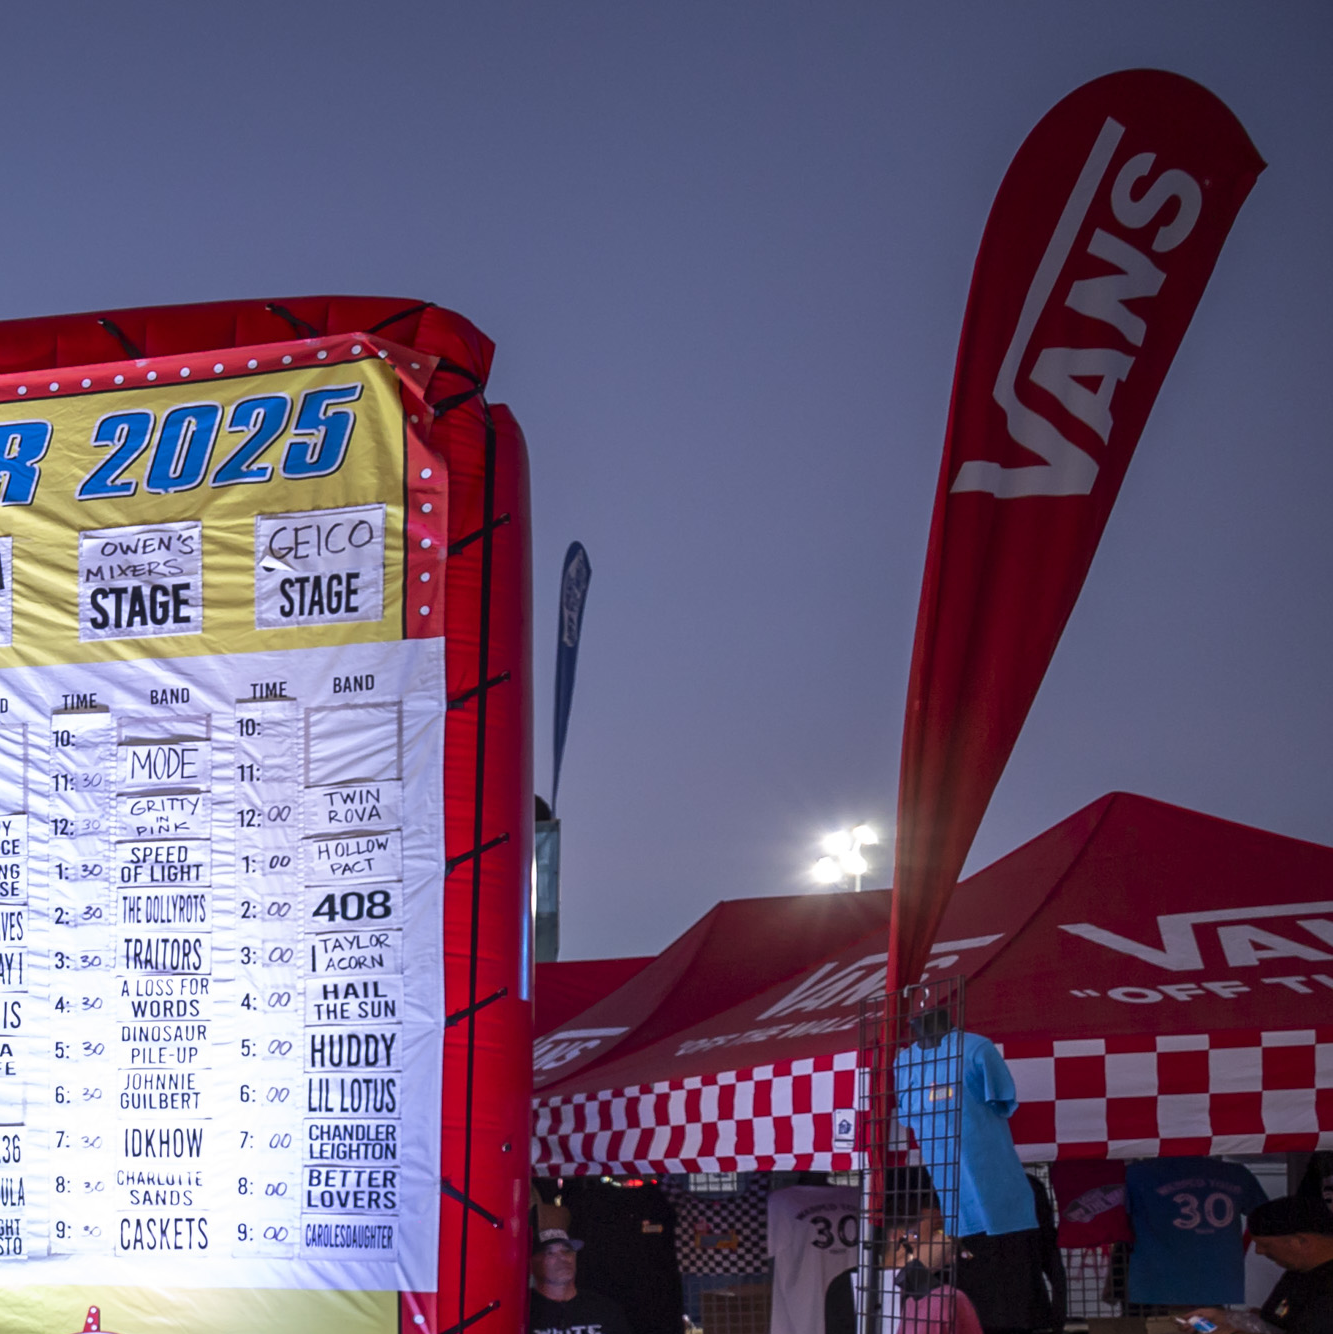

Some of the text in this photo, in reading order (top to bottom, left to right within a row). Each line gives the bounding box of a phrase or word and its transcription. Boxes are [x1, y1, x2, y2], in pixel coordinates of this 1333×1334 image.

[950, 116, 1203, 499] VANS
[77, 382, 364, 502] 2025
[100, 534, 195, 556] OWEN'S
[269, 521, 375, 561] GEICO
[86, 559, 183, 582] MIXERS
[90, 583, 191, 630] STAGE
[280, 573, 359, 618] STAGE
[131, 748, 199, 780] MODE
[130, 798, 200, 816] GRITTY
[323, 788, 381, 806] TWIN
[328, 804, 382, 823] ROVA
[131, 846, 188, 864] SPEED
[317, 838, 389, 860] HOLLOW
[330, 858, 375, 876] PACT
[312, 890, 391, 922] 408
[124, 938, 202, 972] TRAITORS
[4, 1001, 21, 1029] IS
[132, 1000, 199, 1018] WORDS
[131, 1047, 198, 1064] PILE-UP
[311, 1033, 395, 1068] HUDDY
[125, 1128, 203, 1158] IDKHOW
[309, 1124, 396, 1141] CHANDLER
[309, 1142, 396, 1160] LEIGHTON
[308, 1170, 396, 1188] BETTER
[307, 1191, 396, 1209] LOVERS
[1173, 1193, 1233, 1229] 30
[121, 1217, 208, 1251] CASKETS
[811, 1214, 859, 1249] 30
